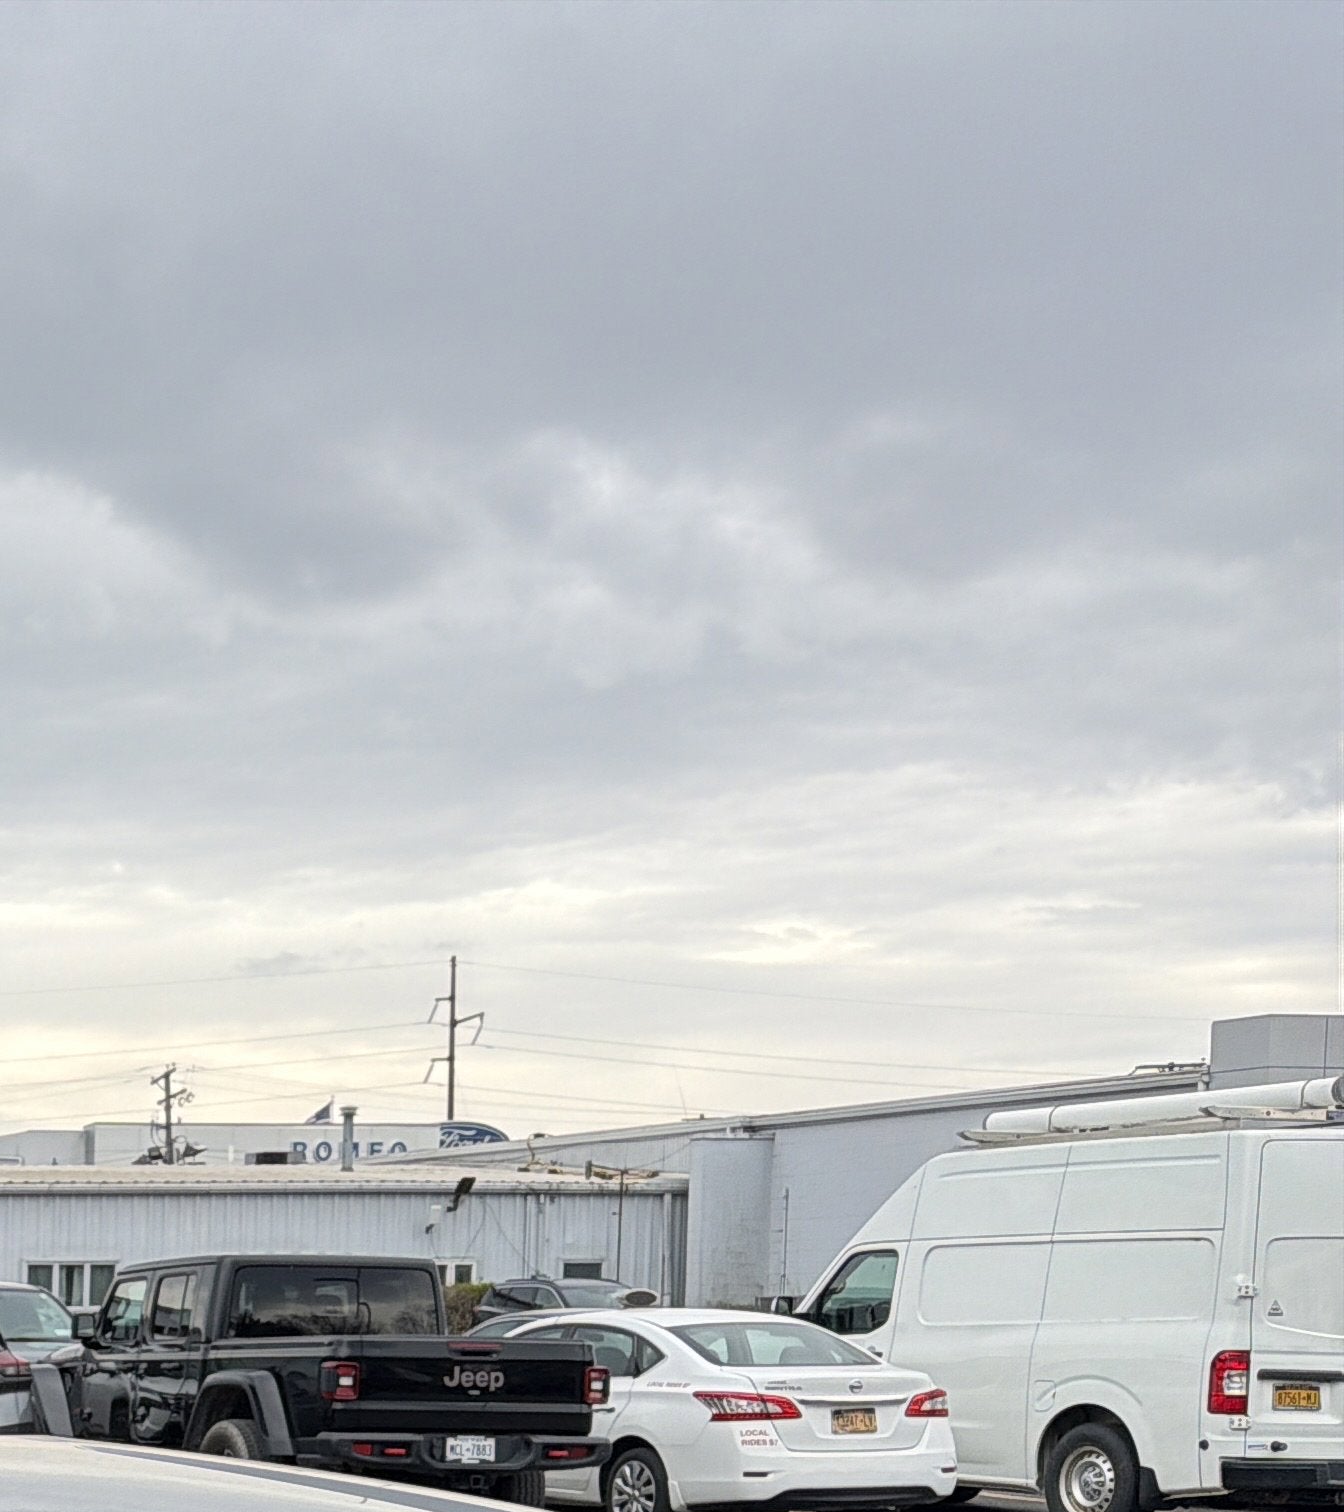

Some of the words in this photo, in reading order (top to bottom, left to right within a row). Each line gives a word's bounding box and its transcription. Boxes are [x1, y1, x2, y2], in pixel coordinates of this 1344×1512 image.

[443, 1365, 504, 1392] Jeep
[740, 1429, 769, 1437] LOCAL
[741, 1438, 767, 1447] RIDES
